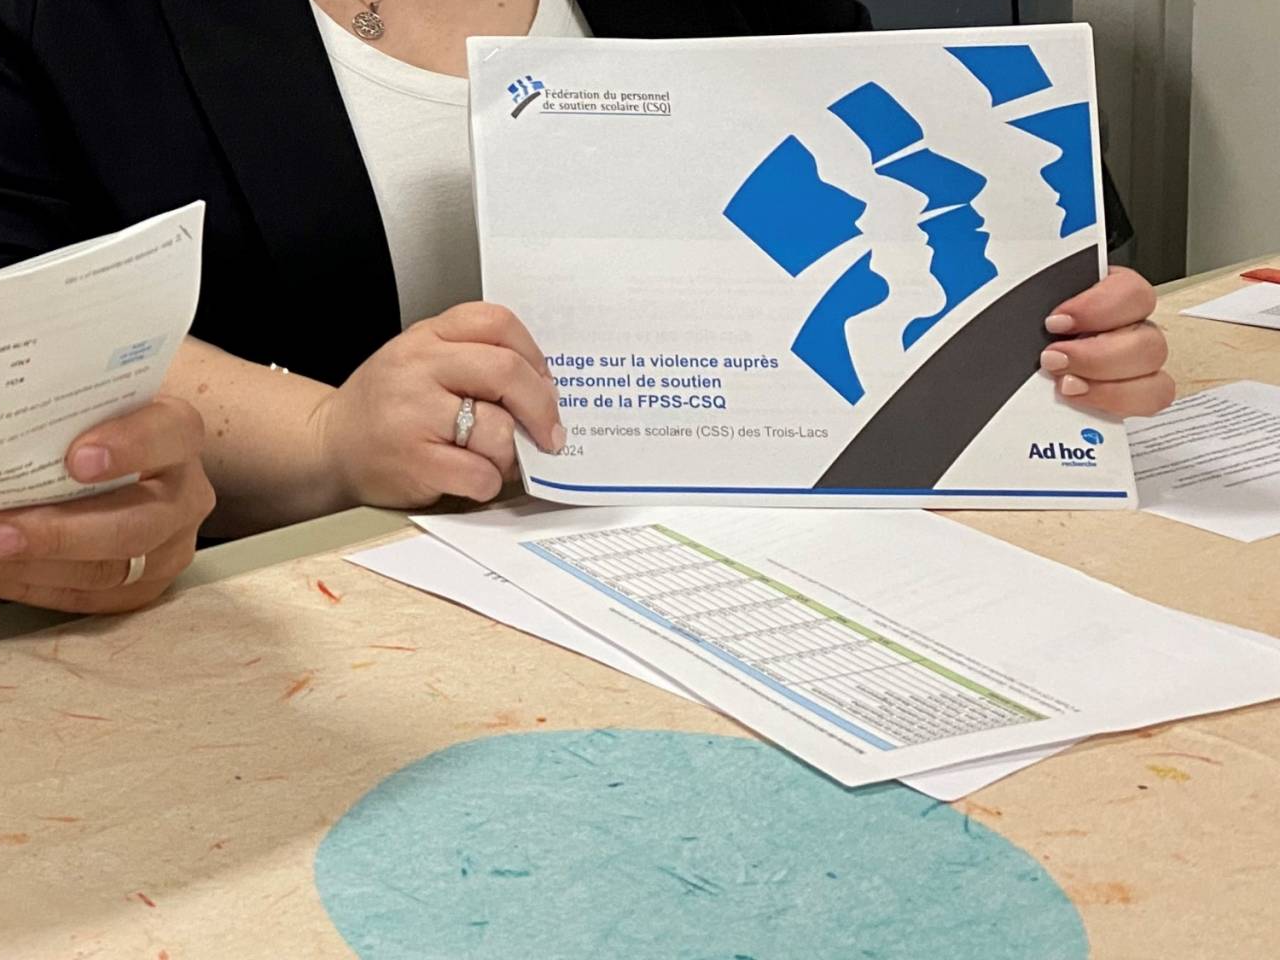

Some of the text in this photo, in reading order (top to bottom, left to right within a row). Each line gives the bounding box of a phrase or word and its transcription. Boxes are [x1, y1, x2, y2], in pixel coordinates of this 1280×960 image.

[545, 89, 670, 103] Fédération du personnel
[542, 100, 671, 114] de soutien scolaire (CSQ)
[545, 354, 779, 372] ndage sur la violence auprès
[636, 375, 656, 388] de
[660, 375, 722, 389] soutien
[559, 394, 727, 410] aire de la FPSS-CSQ
[571, 424, 829, 439] de services scolaire (CSS) des Trois-Lacs
[1029, 442, 1097, 460] Ad hoc
